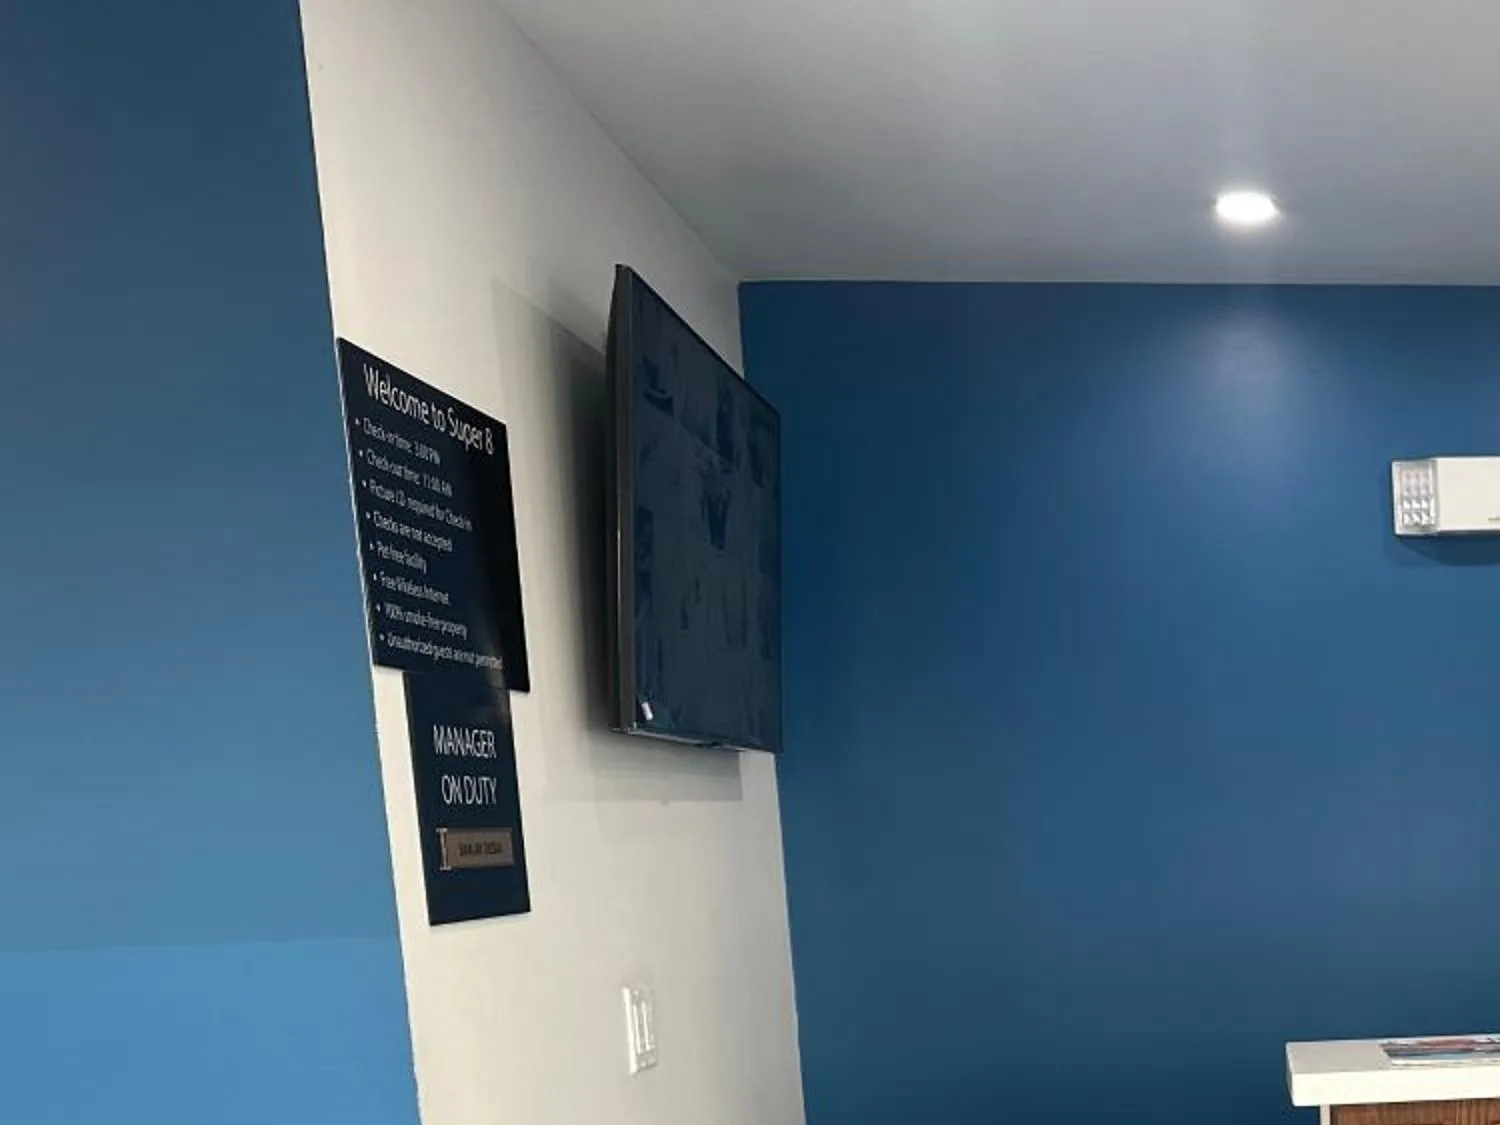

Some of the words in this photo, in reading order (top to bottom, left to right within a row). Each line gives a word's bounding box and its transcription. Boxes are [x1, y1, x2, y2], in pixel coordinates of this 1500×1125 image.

[363, 362, 430, 425] Welcome
[431, 402, 447, 432] to
[448, 408, 483, 453] Super
[485, 427, 494, 455] 8
[433, 724, 497, 758] MANAGER
[441, 775, 463, 805] ON
[463, 776, 497, 805] DUTY
